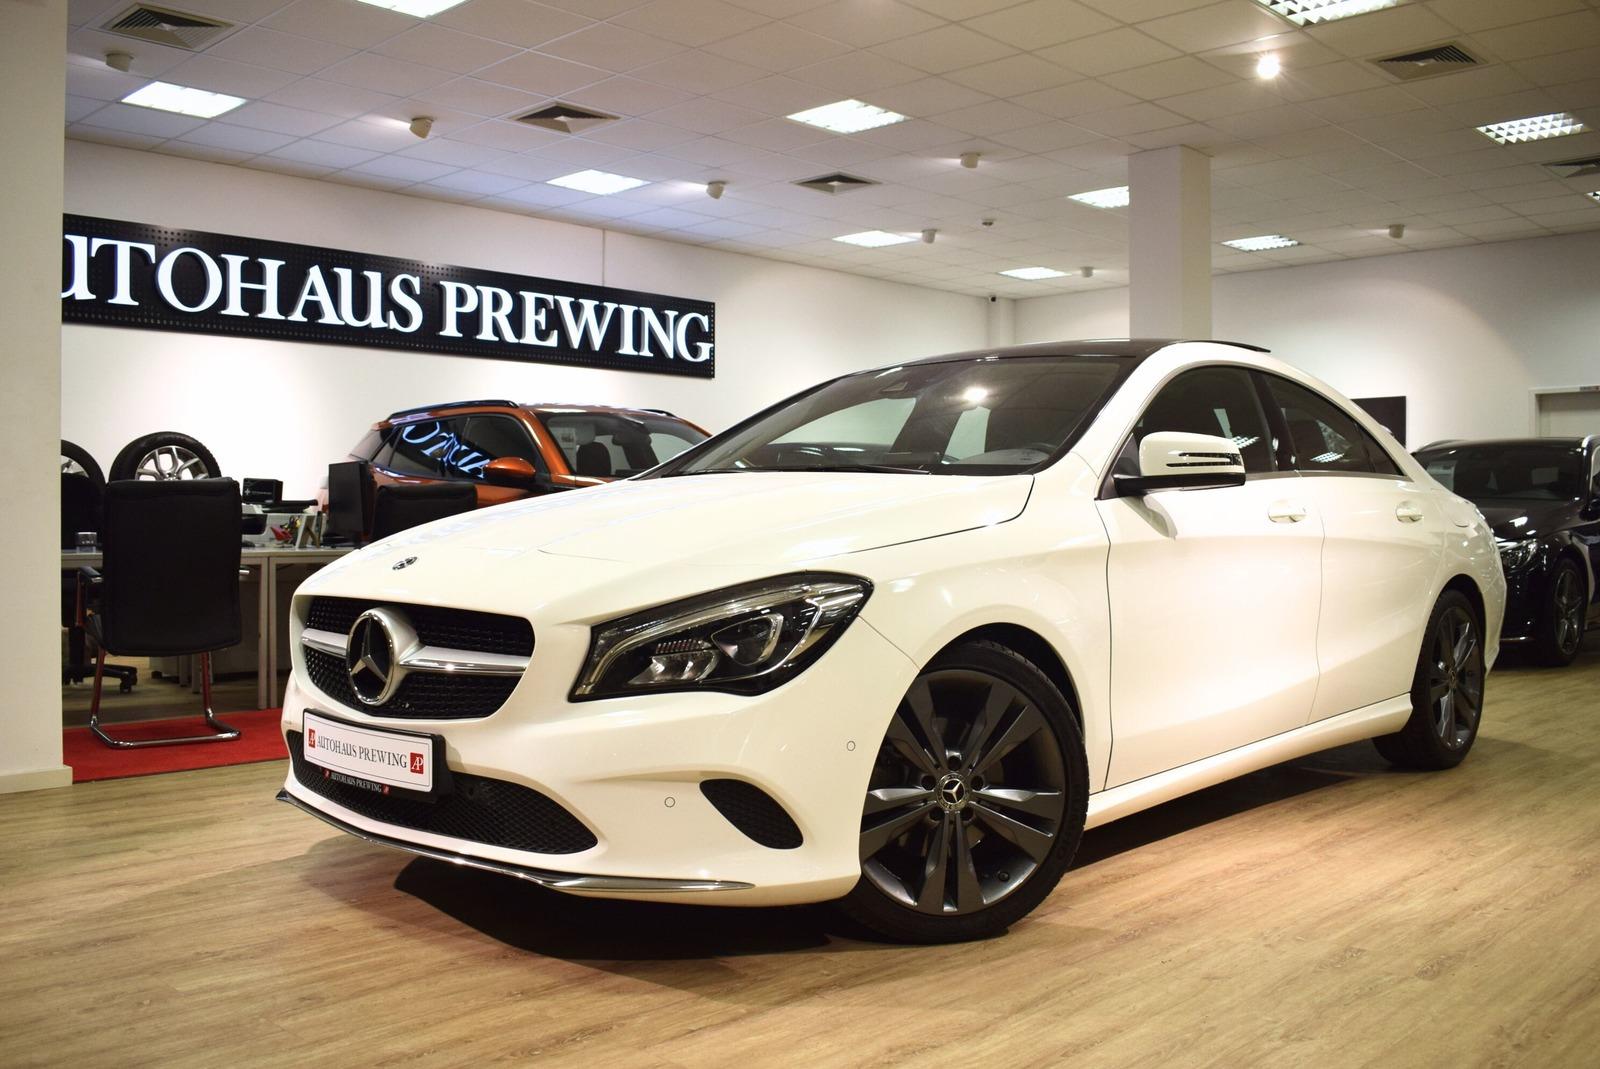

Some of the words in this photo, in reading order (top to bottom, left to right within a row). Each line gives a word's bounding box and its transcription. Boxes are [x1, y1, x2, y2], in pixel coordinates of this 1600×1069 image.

[439, 280, 714, 362] PREWING
[317, 736, 357, 757] AUTOHAUS
[358, 745, 408, 769] PREWING
